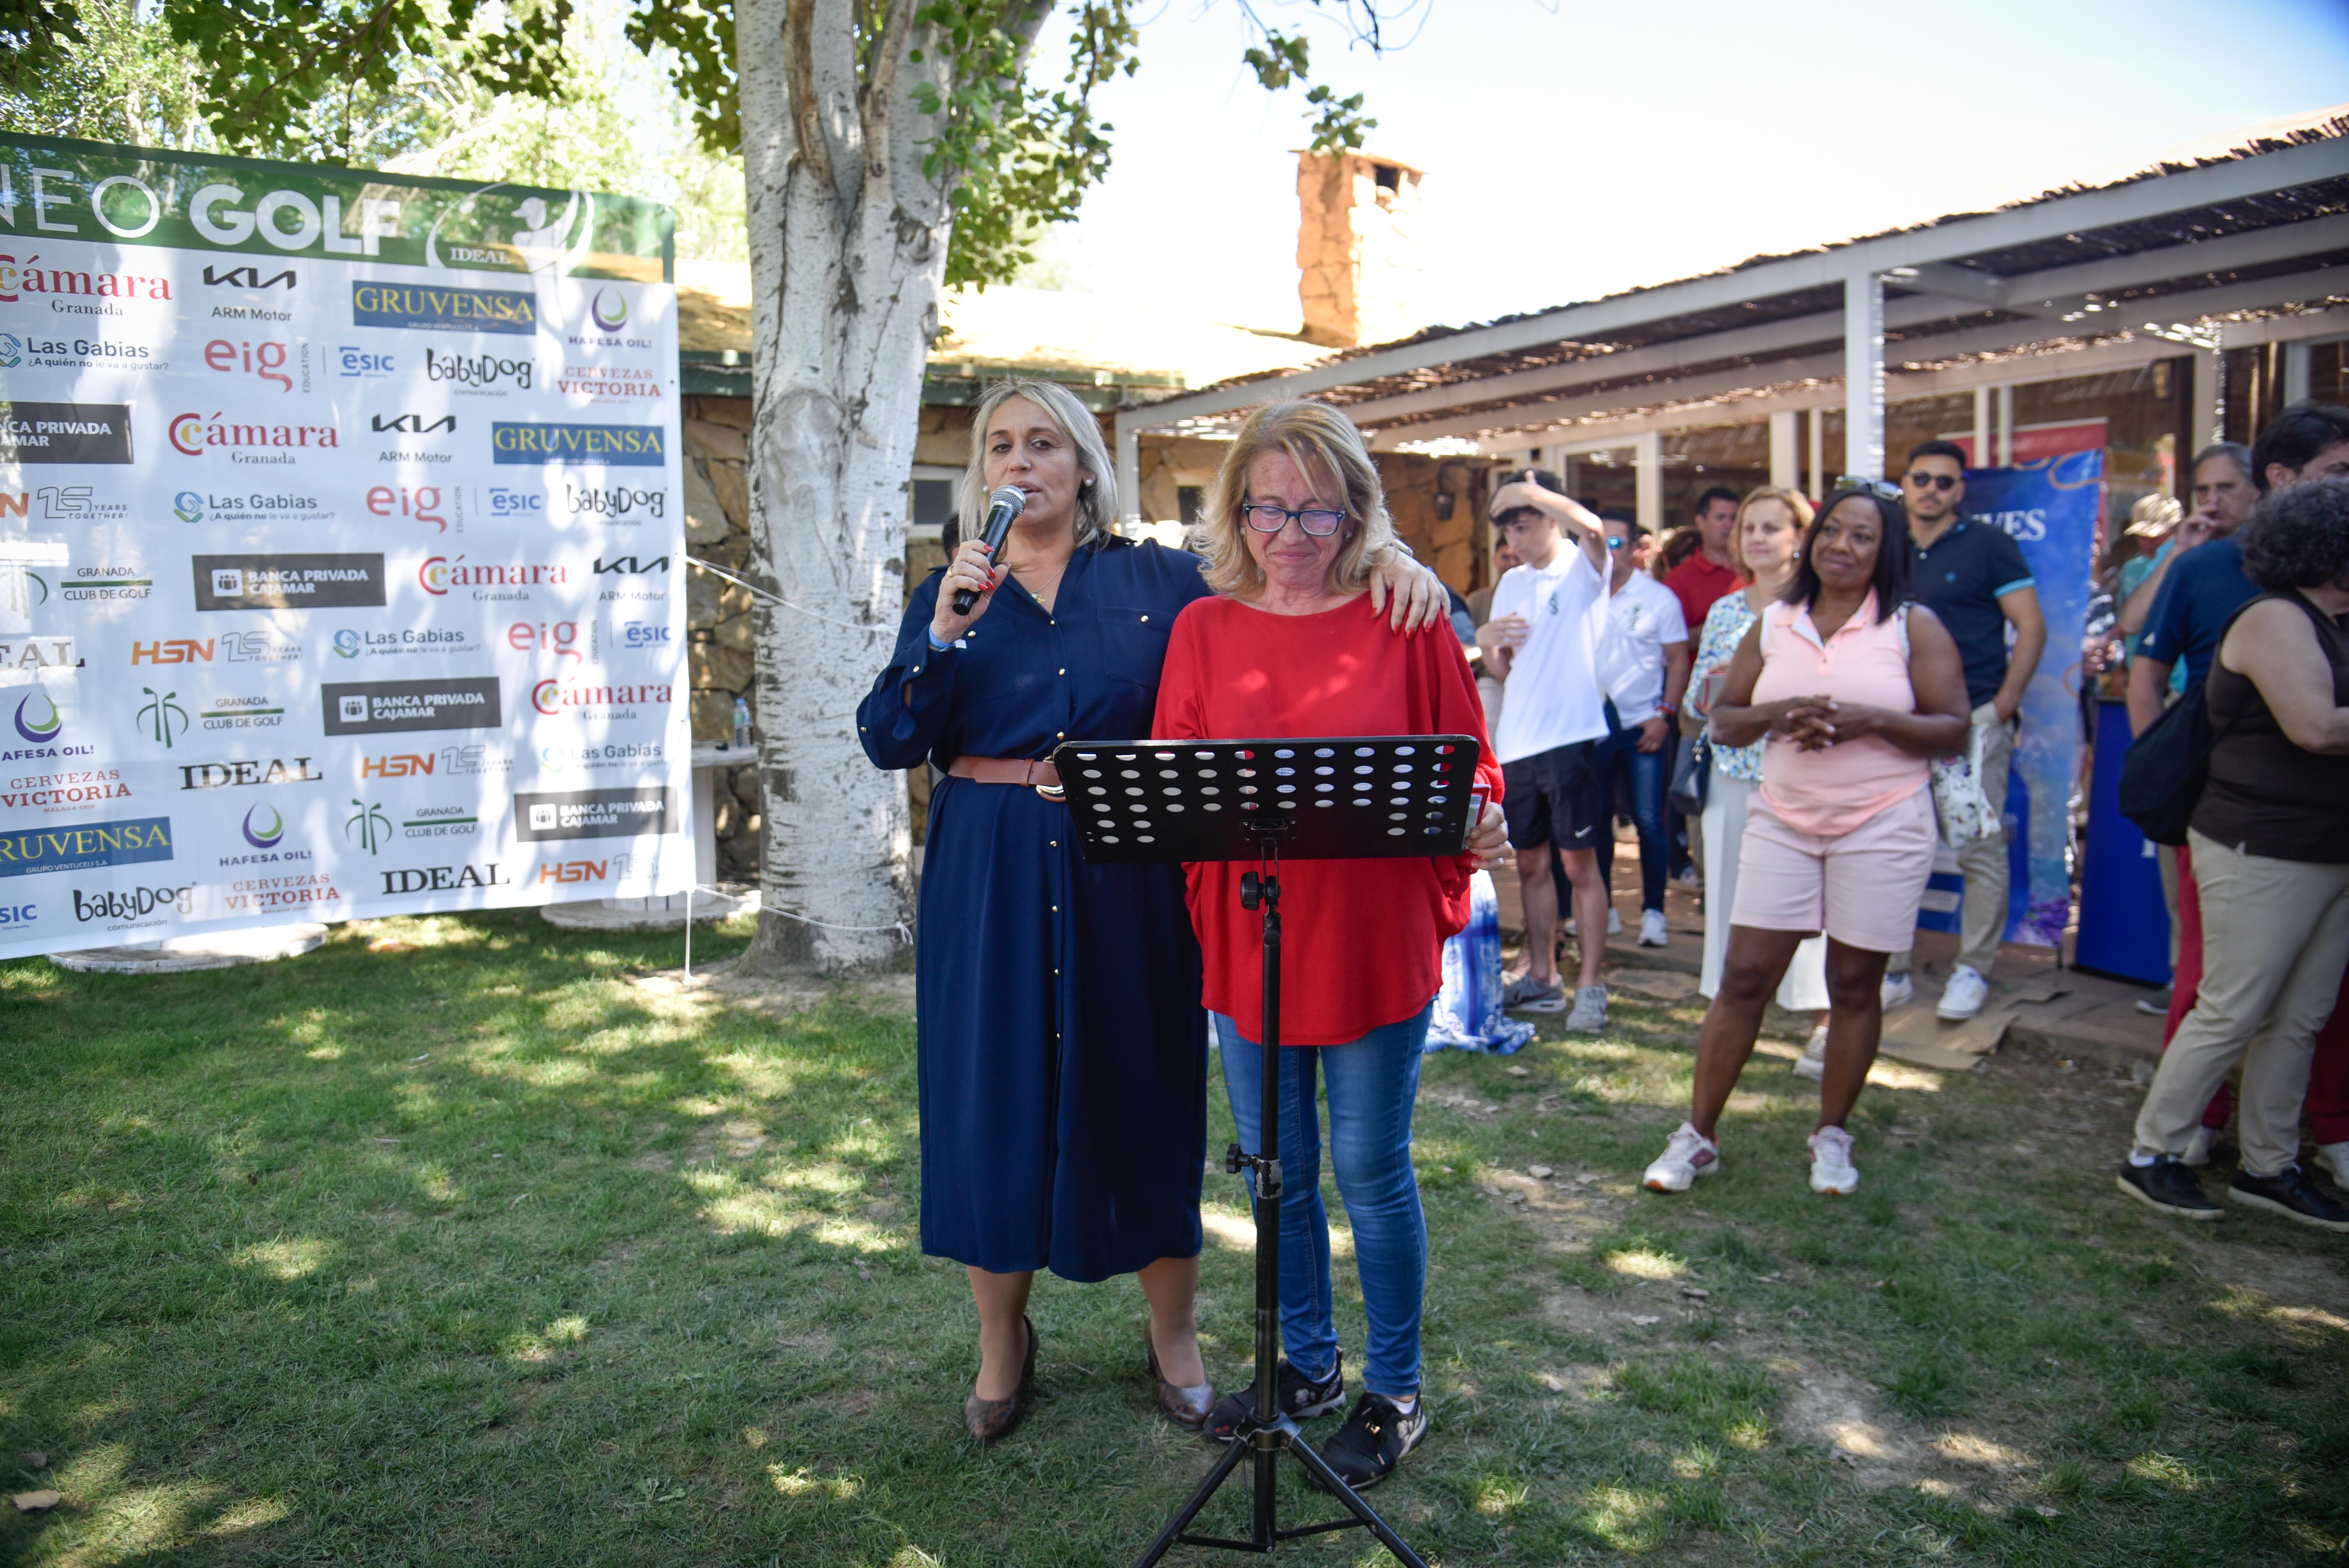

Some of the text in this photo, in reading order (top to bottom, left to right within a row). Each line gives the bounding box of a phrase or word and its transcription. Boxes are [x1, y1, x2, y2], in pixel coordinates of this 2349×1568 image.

[0, 163, 401, 256] EO GOLF
[450, 246, 511, 265] IDEAL
[52, 299, 123, 316] Granada
[355, 287, 535, 322] GRUVENSA
[212, 306, 292, 321] ARM Motor
[27, 337, 150, 358] Las Gabias
[627, 339, 652, 348] OIL!
[29, 358, 43, 367] ¿A
[45, 358, 77, 368] quién
[96, 360, 105, 368] le
[131, 362, 169, 371] gustar?
[204, 339, 293, 394] eig
[302, 342, 311, 393] EDUCATION
[565, 366, 653, 380] CERVEZAS
[454, 388, 508, 397] comunicación
[557, 380, 662, 396] VICTORIA
[36, 421, 112, 435] PRIVADA
[169, 411, 339, 456] Cámara
[494, 427, 663, 454] GRUVENSA
[232, 450, 296, 464] Granada
[379, 451, 453, 463] ARM Motor
[209, 494, 318, 510] Las Gabias
[366, 485, 447, 534] eig
[209, 513, 223, 521] ¿A
[224, 512, 252, 521] quién
[300, 512, 335, 521] gustar?
[77, 567, 135, 577] GRANADA
[248, 569, 369, 583] BANCA PRIVADA
[419, 554, 567, 595] Cámara
[64, 588, 152, 601] CLUB DE GOLF
[248, 583, 315, 597] CAJAMAR
[472, 589, 530, 601] Granada
[599, 591, 666, 601] ARM Motor
[365, 629, 465, 645] Las Gabias
[508, 621, 583, 666] eig
[131, 638, 215, 666] HSN
[216, 696, 269, 707] GRANADA
[372, 692, 486, 708] BANCA PRIVADA
[531, 677, 673, 715] Cámara
[372, 706, 436, 722] CAJAMAR
[203, 715, 284, 730] CLUB DE GOLF
[0, 745, 94, 761] AFESA OIL!
[604, 743, 662, 759] Gabias
[179, 757, 323, 790] IDEAL
[361, 753, 435, 779] HSN
[10, 769, 120, 789] CERVEZAS
[1, 783, 132, 808] VICTORIA
[416, 806, 464, 817] GRANADA
[559, 800, 665, 817] BANCA PRIVADA
[560, 814, 618, 829] CAJAMAR
[405, 824, 478, 838] CLUB DE GOLF
[219, 850, 312, 867] HAFESA OIL!
[26, 865, 53, 874] GRUPO
[55, 861, 94, 871] VENTUCELI
[539, 859, 608, 884] HSN
[233, 873, 330, 892] CERVEZAS
[380, 863, 510, 895] IDEAL
[225, 886, 341, 909] VICTORIA
[107, 919, 168, 932] comunicación
